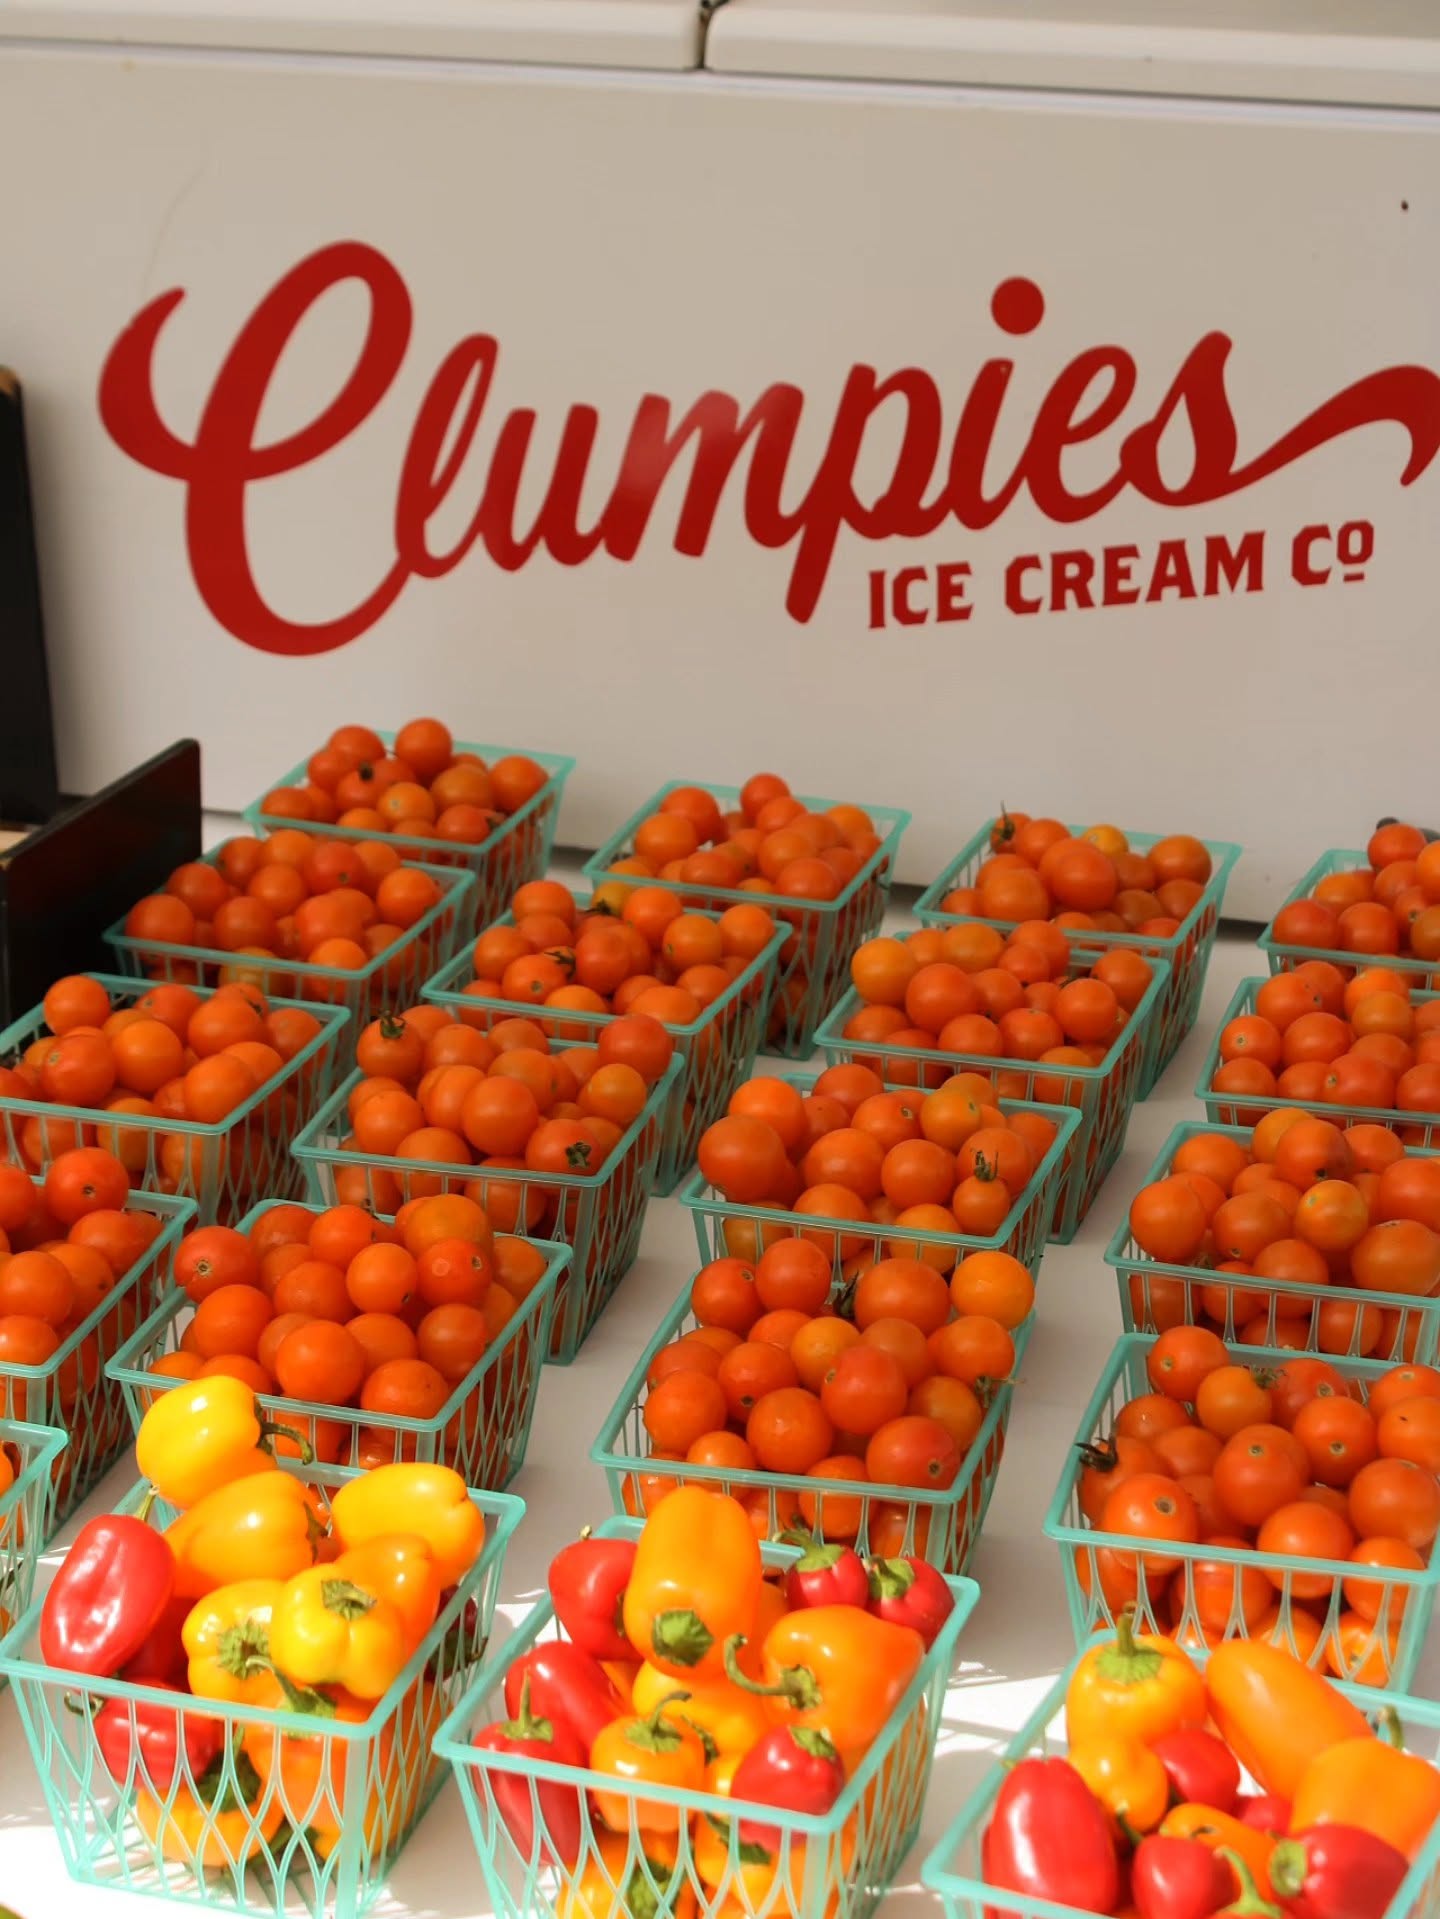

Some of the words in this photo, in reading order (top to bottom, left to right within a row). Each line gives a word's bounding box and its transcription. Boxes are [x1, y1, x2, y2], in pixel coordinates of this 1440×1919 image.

[98, 240, 1440, 657] Clumpies
[868, 561, 973, 631] ICE
[1004, 530, 1266, 617] CREAM
